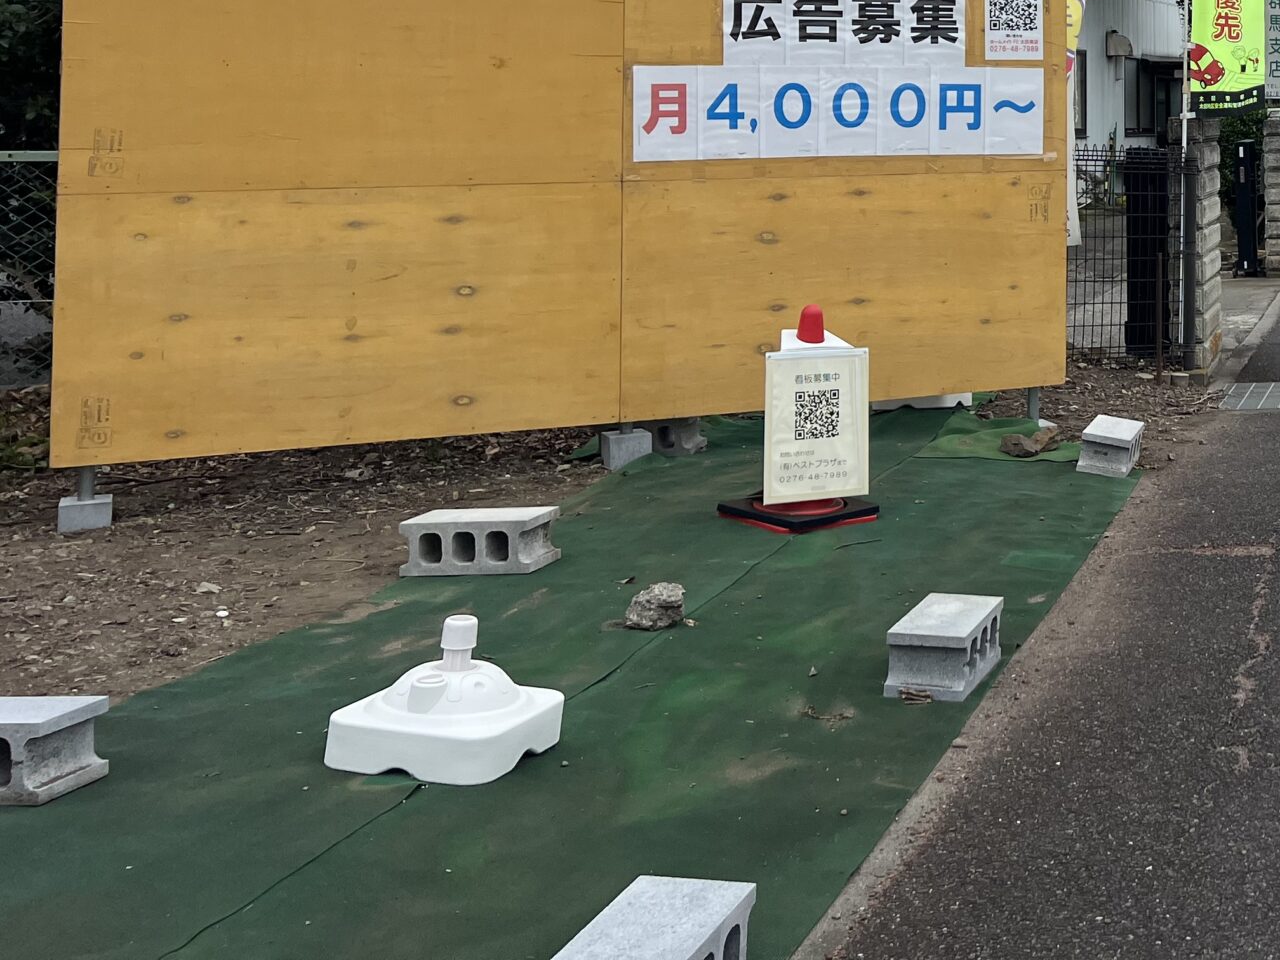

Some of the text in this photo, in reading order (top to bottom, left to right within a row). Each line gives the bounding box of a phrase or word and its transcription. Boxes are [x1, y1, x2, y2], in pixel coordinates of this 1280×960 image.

[795, 372, 840, 385] 看板募集中
[779, 470, 848, 484] 0276-48-7989
